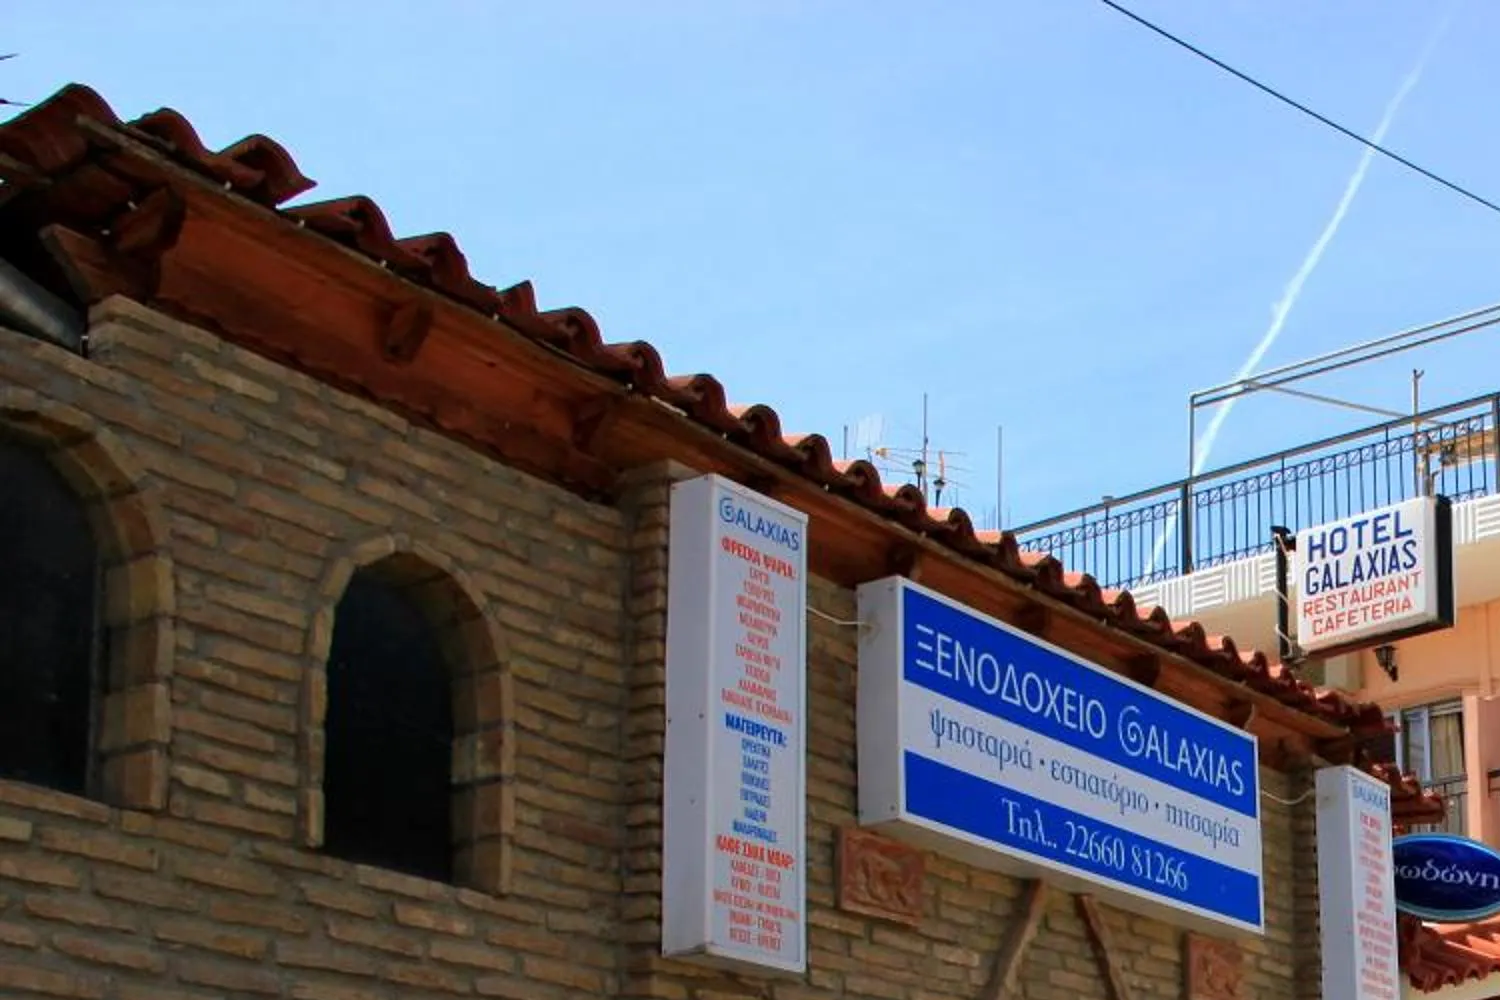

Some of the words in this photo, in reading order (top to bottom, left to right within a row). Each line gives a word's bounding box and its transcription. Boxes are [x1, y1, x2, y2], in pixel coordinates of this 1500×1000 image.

[720, 497, 799, 551] GALAXIAS
[1307, 511, 1413, 562] HOTEL
[1303, 571, 1422, 619] RESTAURANT
[1305, 540, 1417, 596] GALAXIAS
[1312, 598, 1412, 636] CAFETERIA
[915, 624, 1107, 739] ΞΕΝΟΔΟΧΕΙΟ
[1117, 705, 1245, 796] GALAXIAS
[930, 708, 1032, 771] ψησταριά
[1050, 758, 1149, 816] εστιατόριο
[1165, 802, 1240, 849] πιτσαρία
[1064, 821, 1125, 871] 22660
[1131, 844, 1189, 892] 81266
